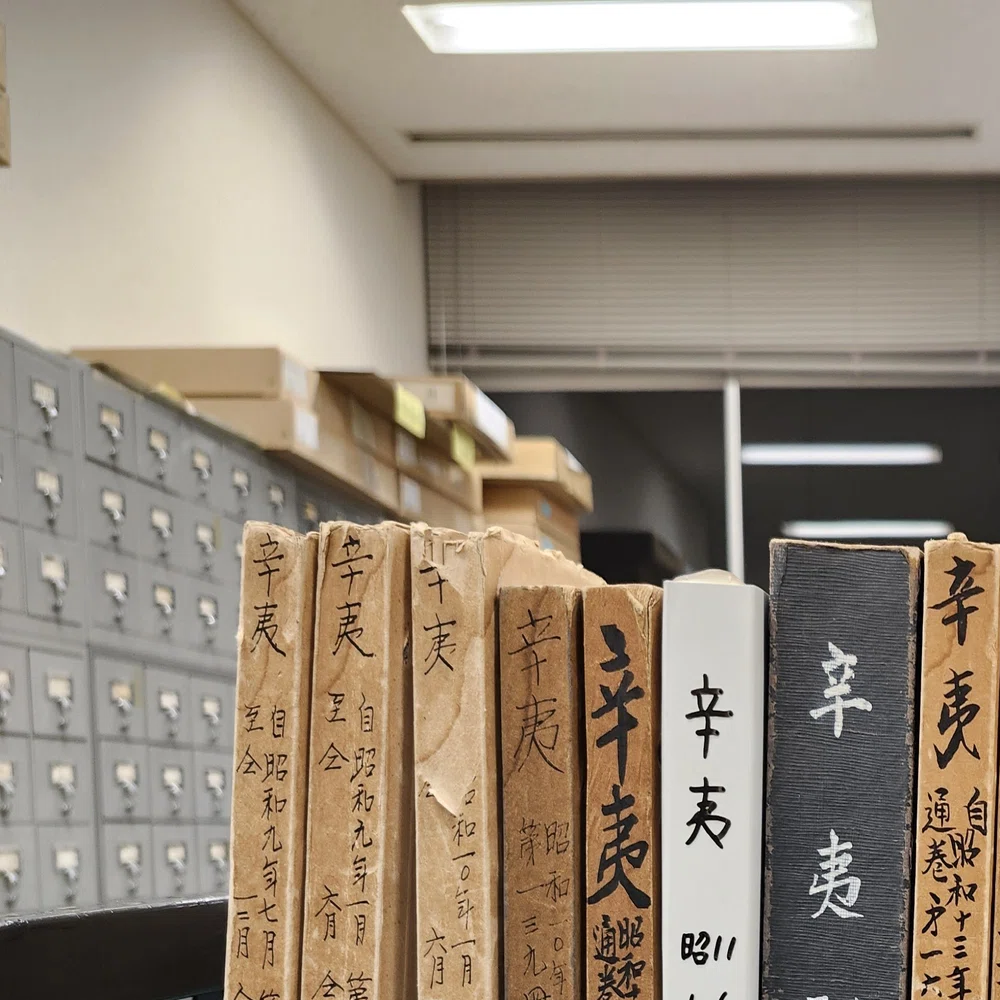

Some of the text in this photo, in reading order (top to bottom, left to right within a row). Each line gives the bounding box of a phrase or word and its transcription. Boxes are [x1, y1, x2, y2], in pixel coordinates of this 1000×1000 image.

[250, 533, 286, 657] 辛夷
[332, 534, 375, 658] 辛夷
[928, 556, 985, 769] 辛夷
[508, 609, 564, 773] 辛夷
[587, 624, 651, 908] 辛夷
[685, 673, 733, 849] 辛夷
[809, 641, 872, 919] 辛夷
[681, 931, 736, 965] 昭11
